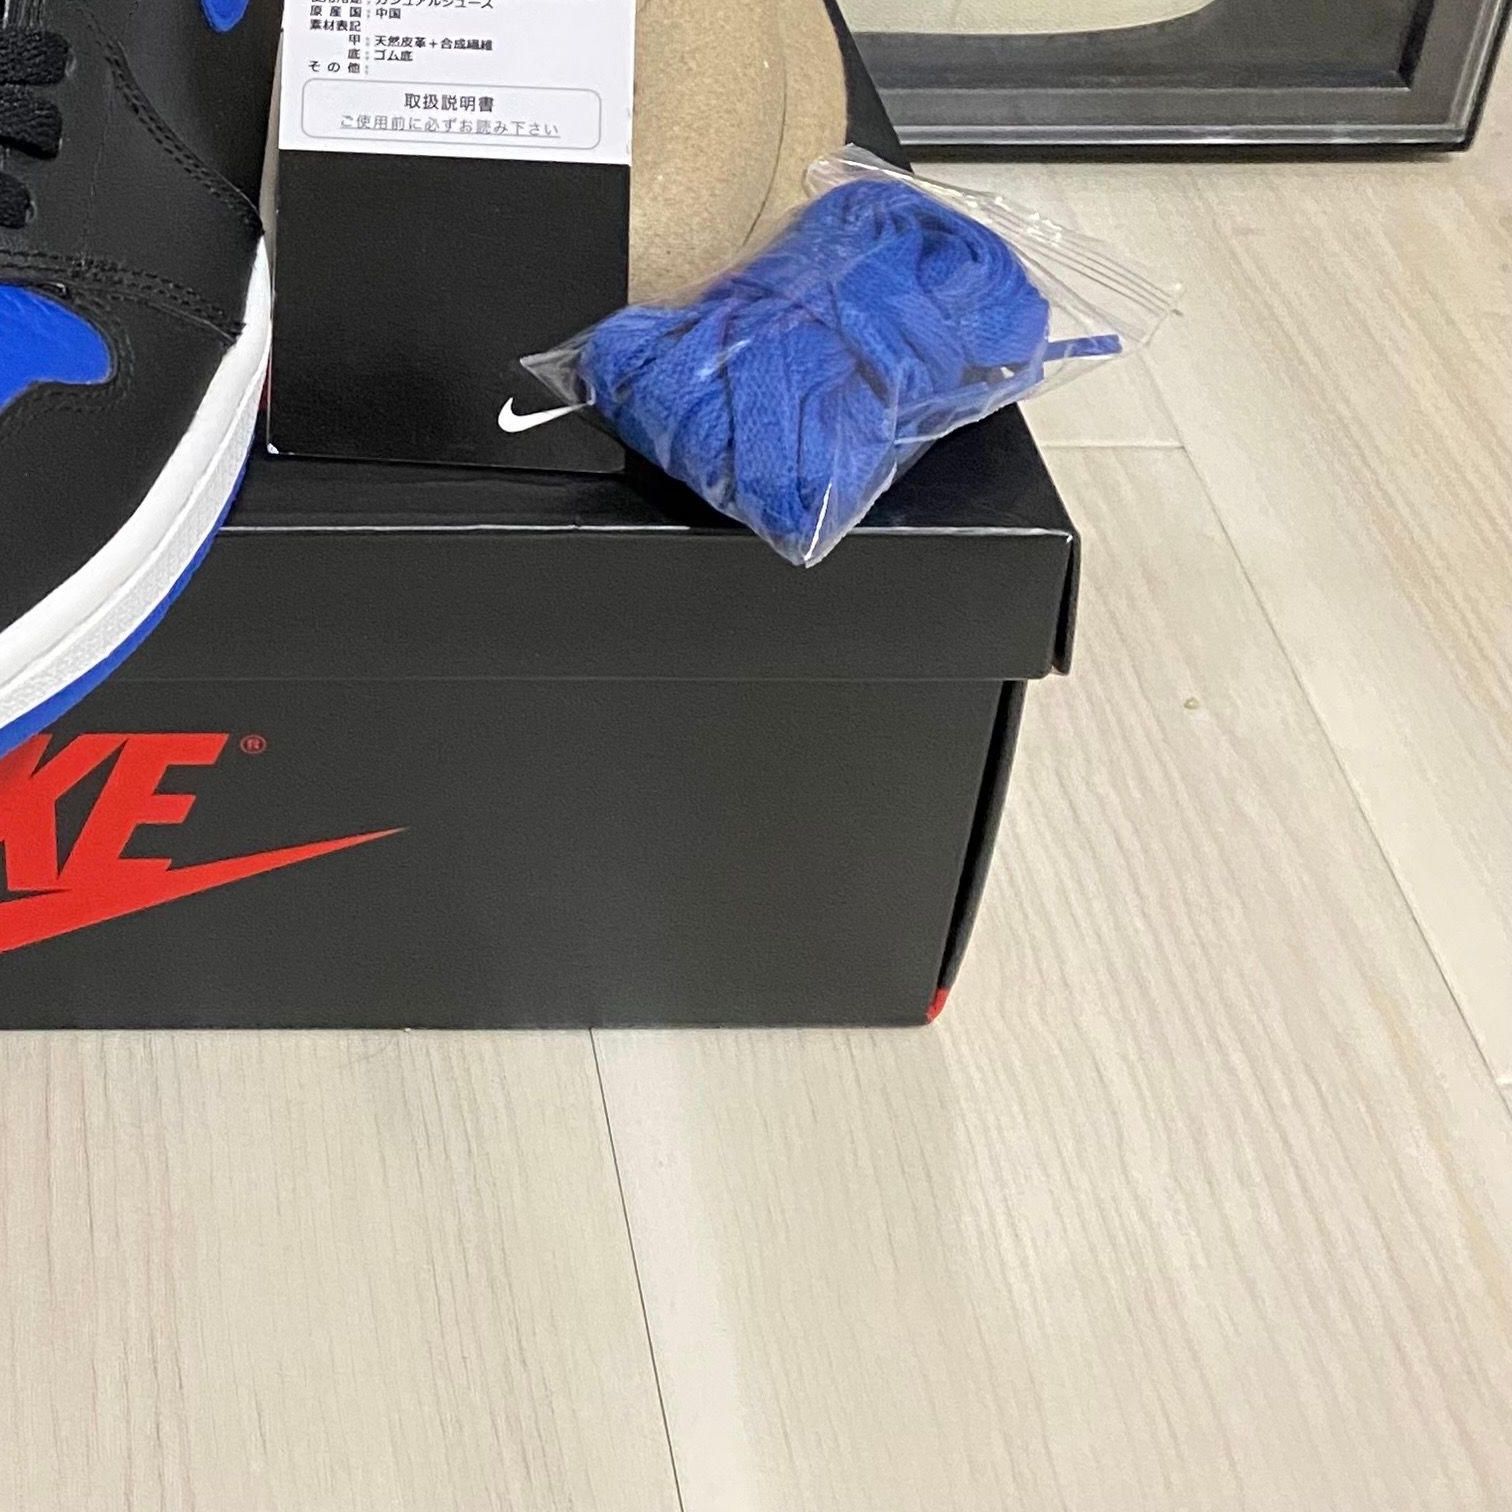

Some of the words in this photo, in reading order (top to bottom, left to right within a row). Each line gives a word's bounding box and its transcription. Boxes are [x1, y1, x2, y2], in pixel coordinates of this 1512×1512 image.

[375, 7, 401, 20] 中国
[404, 93, 495, 113] 取扱説明書
[340, 114, 559, 137] ご使用前に必ずお読み下さい
